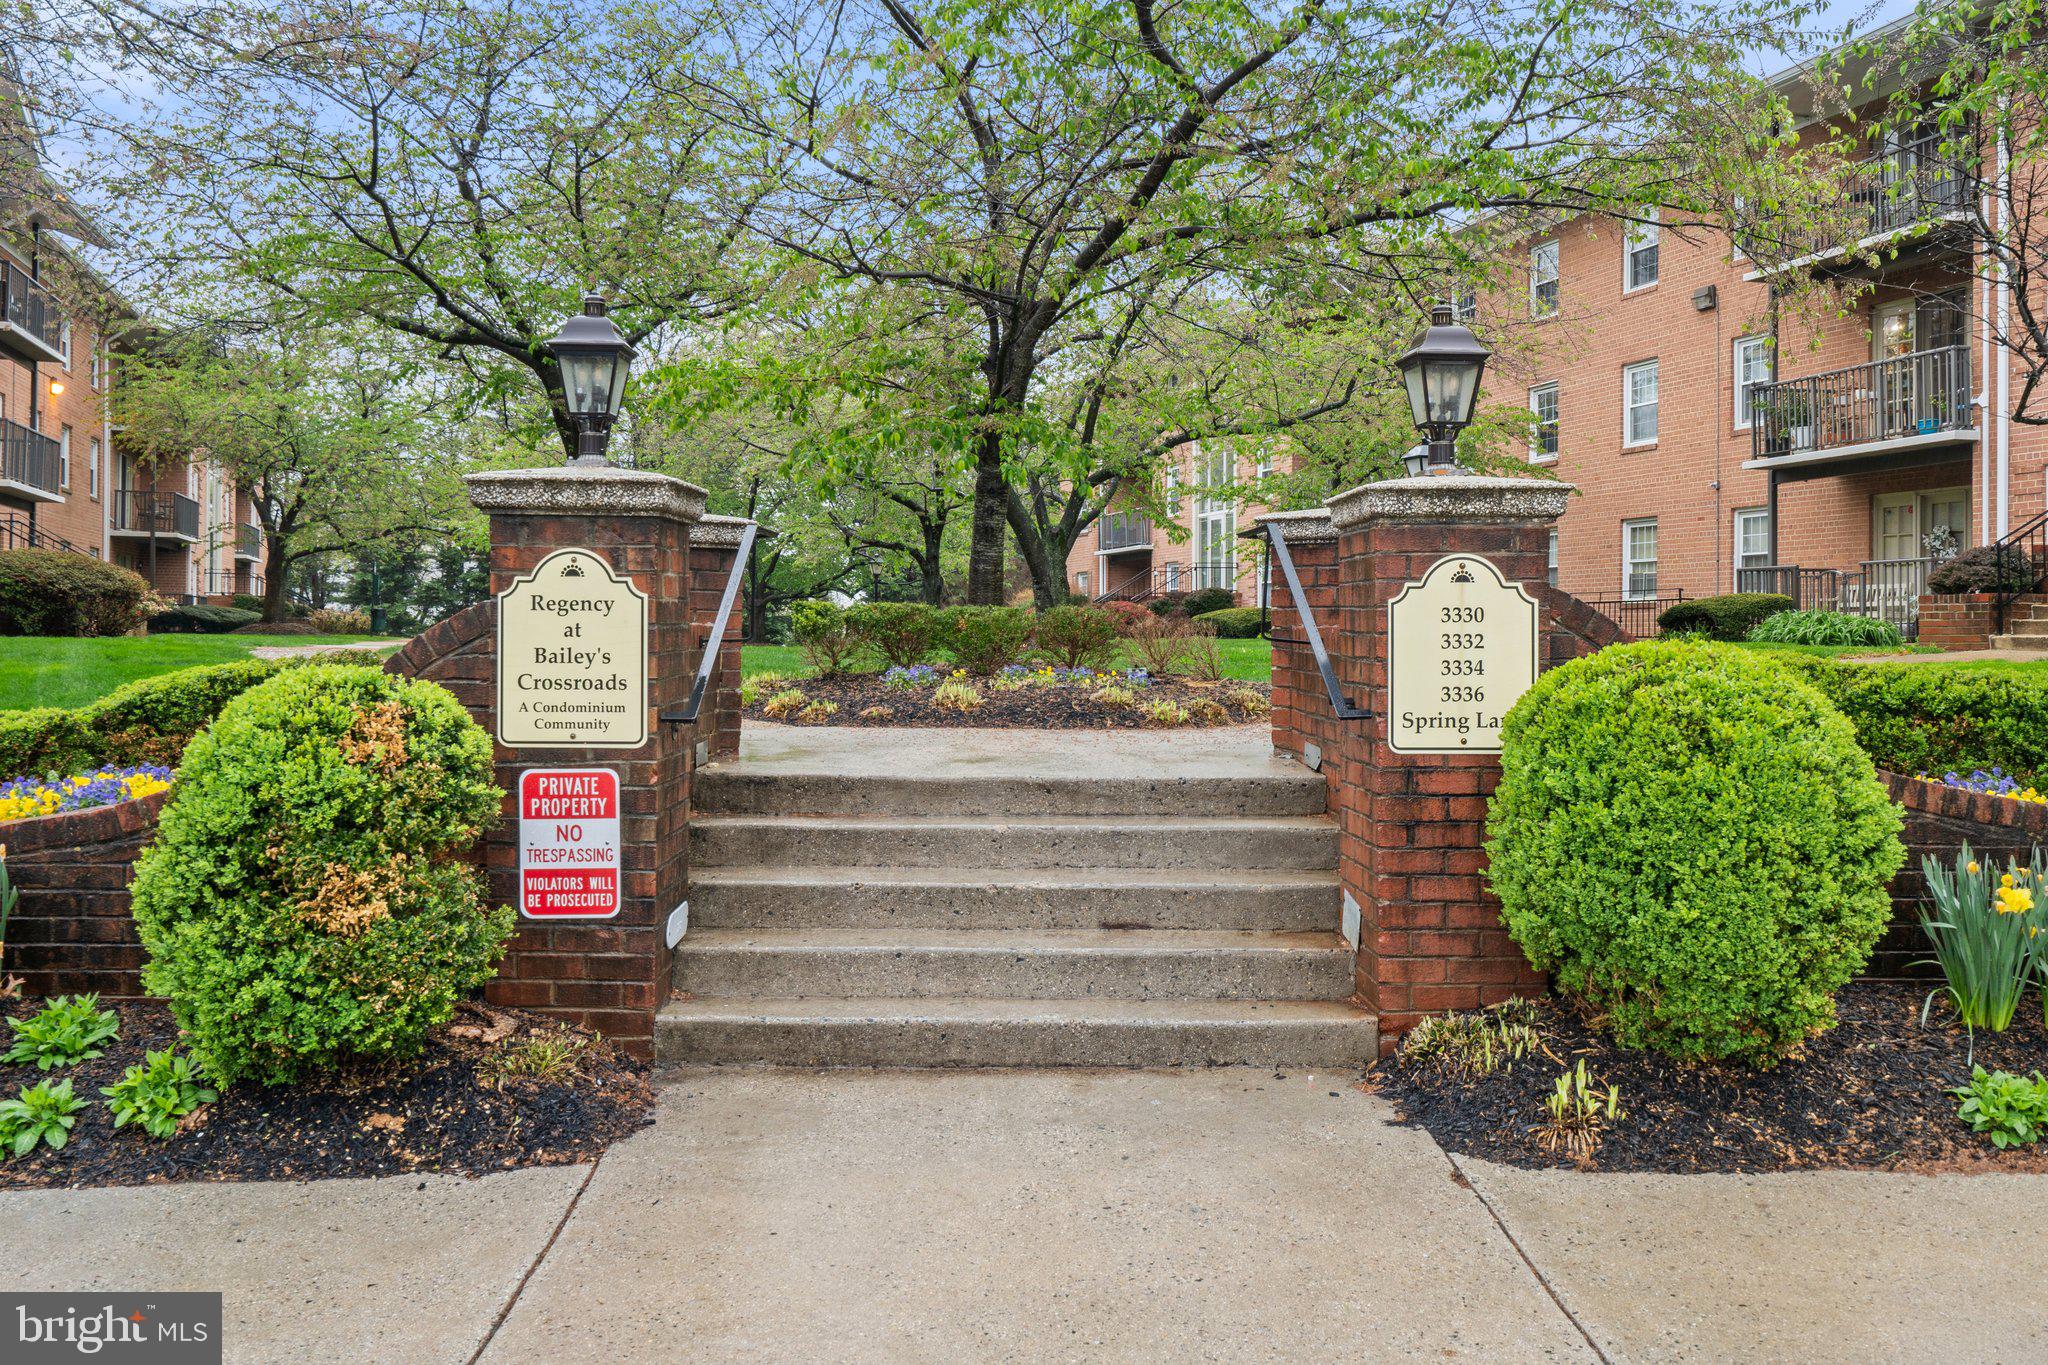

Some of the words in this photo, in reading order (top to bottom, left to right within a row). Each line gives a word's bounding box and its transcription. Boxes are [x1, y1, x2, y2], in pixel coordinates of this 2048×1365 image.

[530, 594, 615, 617] Regency
[1440, 607, 1485, 624] 3330
[563, 623, 582, 638] at
[1440, 633, 1485, 650] 3332
[534, 647, 611, 670] Bailey's
[1440, 660, 1485, 677] 3334
[517, 673, 628, 691] Crossroads
[1440, 686, 1485, 703] 3336
[518, 702, 529, 713] A
[533, 702, 626, 714] Condominium
[534, 718, 610, 733] Community
[1402, 711, 1470, 735] Spring
[539, 777, 599, 796] PRIVATE
[531, 797, 607, 817] PROPERTY
[556, 824, 583, 843] NO
[526, 848, 614, 863] TRESPASSING
[526, 877, 584, 891] VIOLATORS
[589, 877, 614, 891] WILL
[527, 894, 541, 908] BE
[546, 894, 613, 908] PROSECUTED
